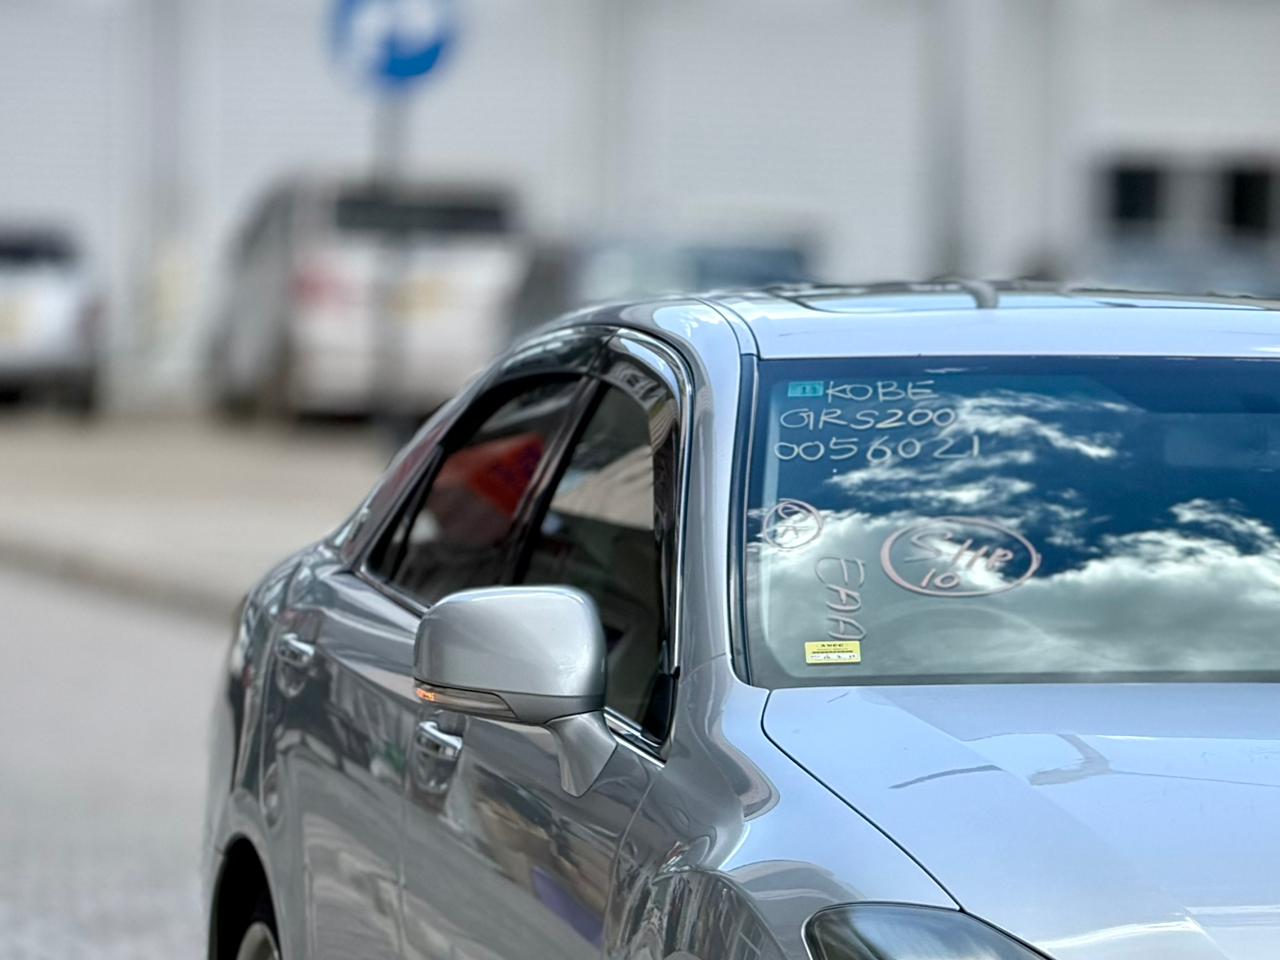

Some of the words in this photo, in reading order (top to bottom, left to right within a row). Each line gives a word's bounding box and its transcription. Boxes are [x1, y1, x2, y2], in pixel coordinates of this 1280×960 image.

[825, 380, 939, 402] KOBE
[780, 408, 956, 430] GRS200
[774, 435, 979, 462] 0056021
